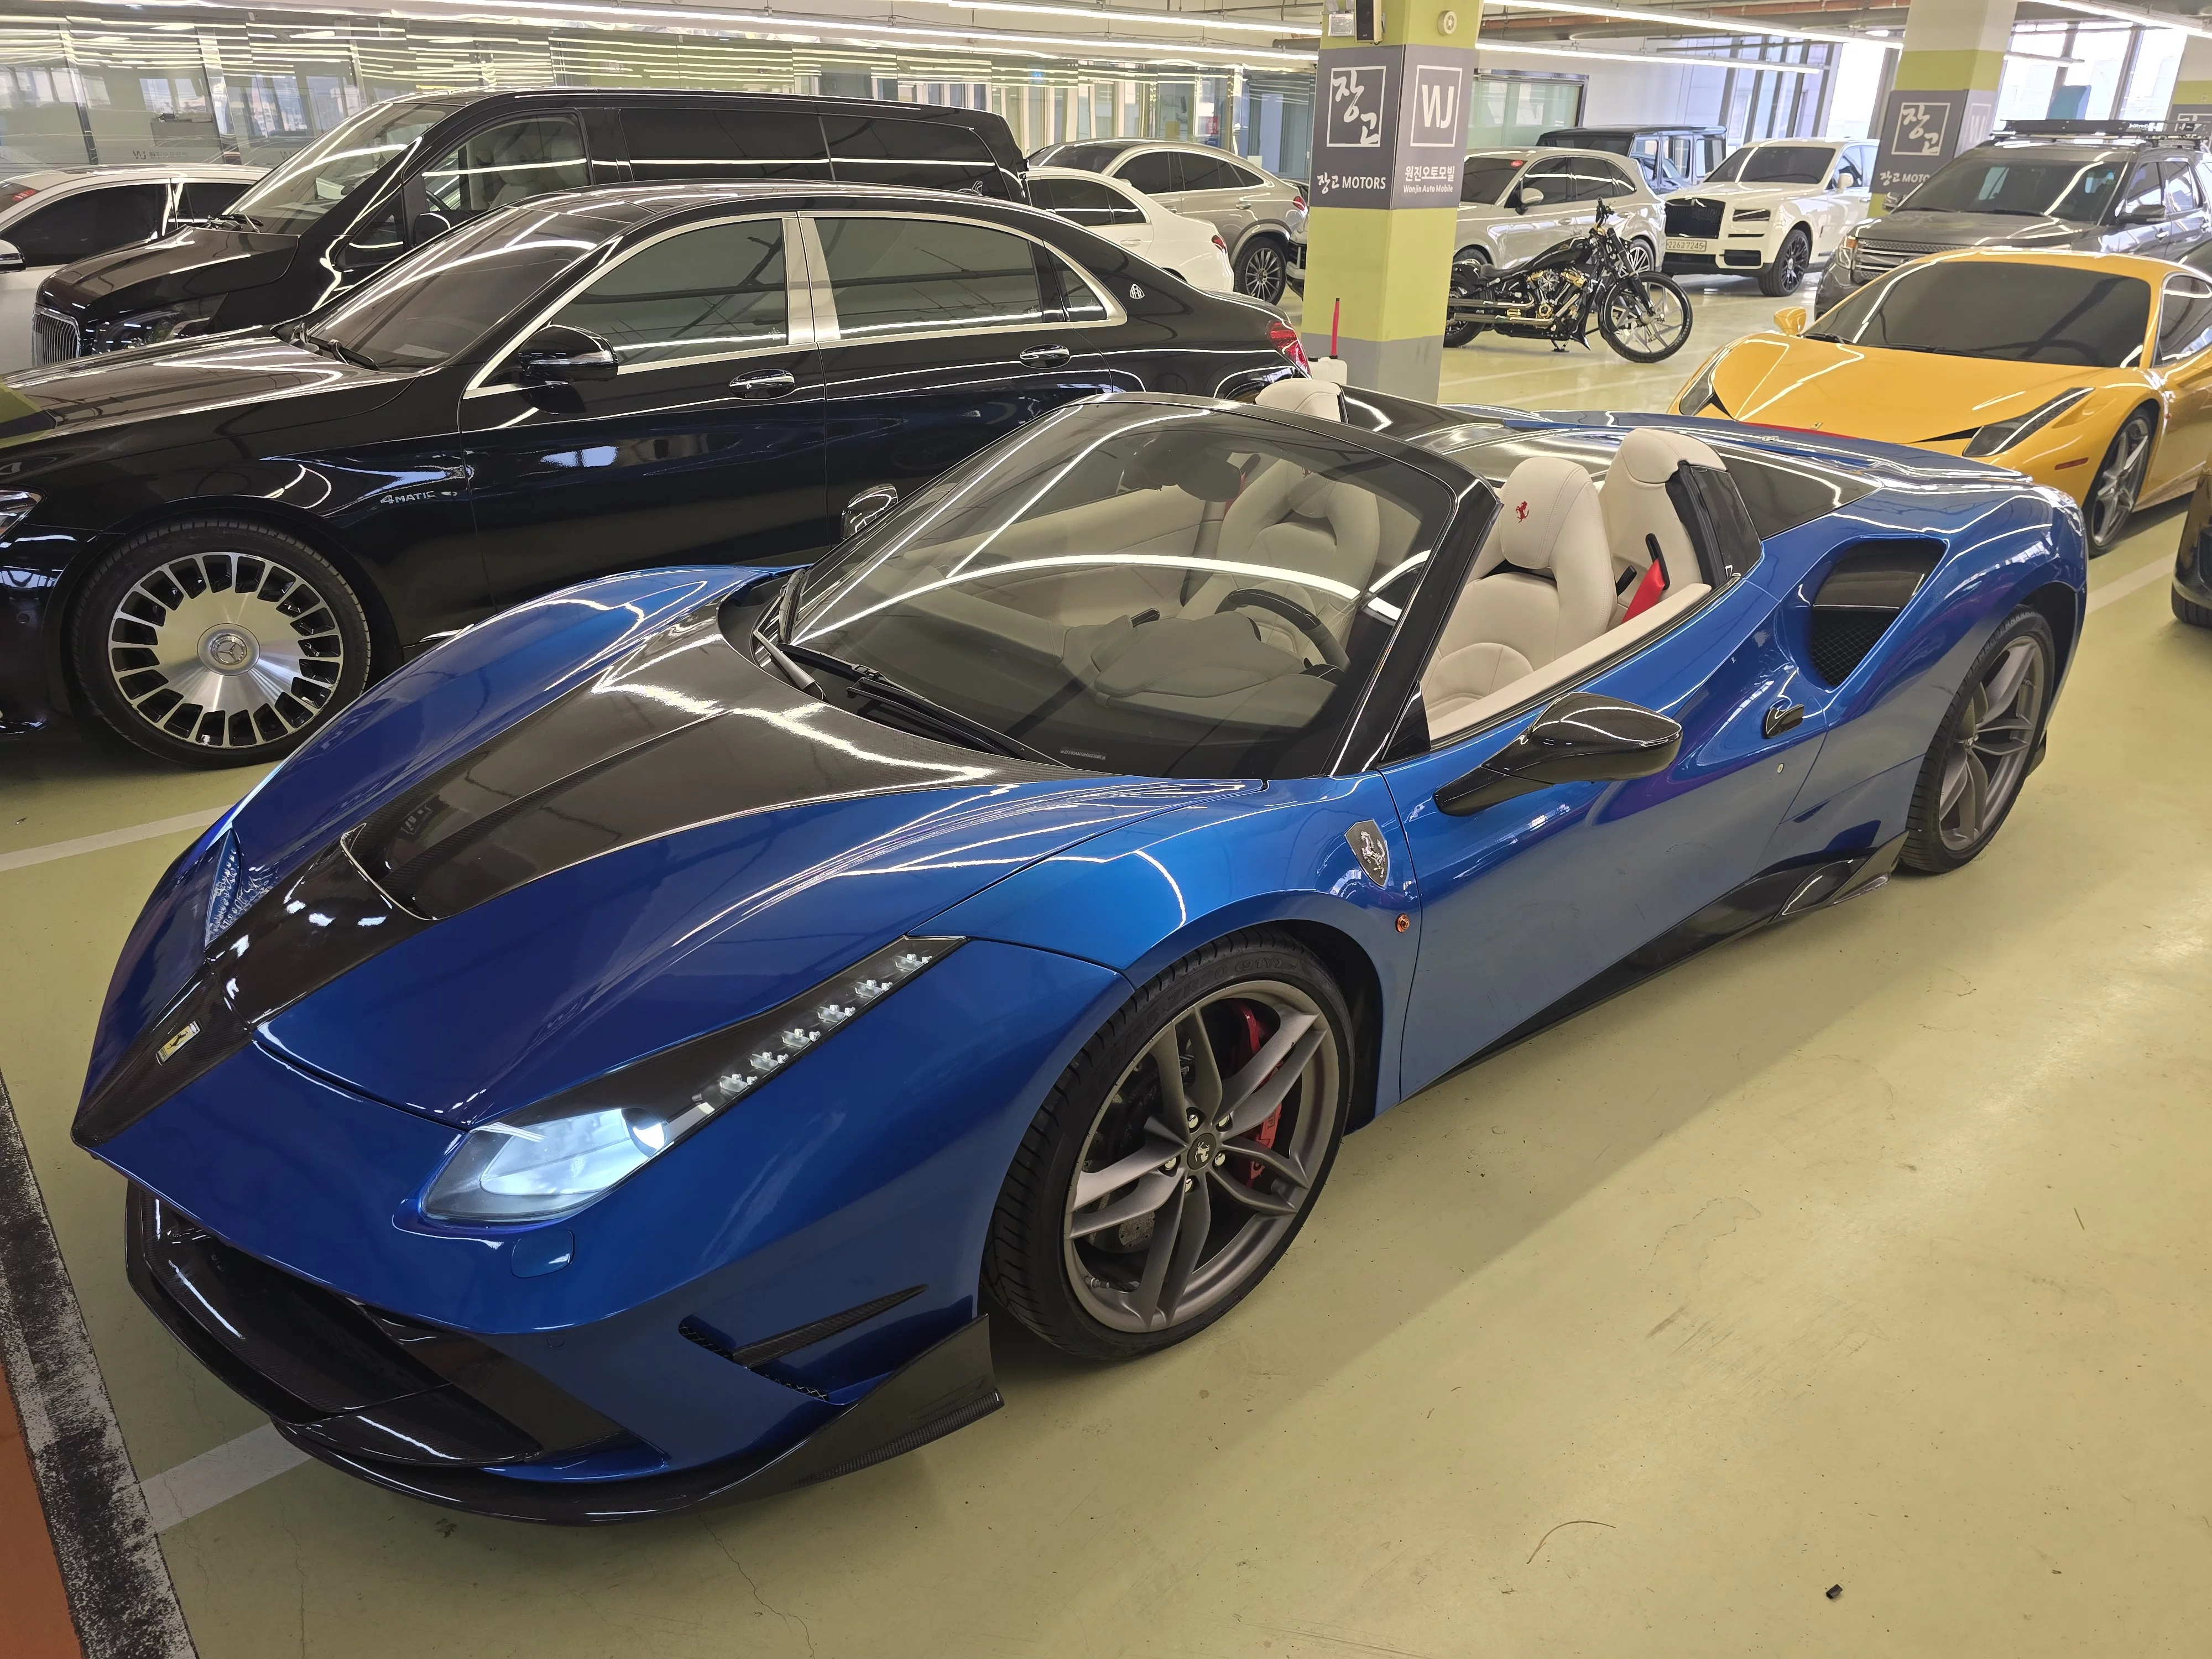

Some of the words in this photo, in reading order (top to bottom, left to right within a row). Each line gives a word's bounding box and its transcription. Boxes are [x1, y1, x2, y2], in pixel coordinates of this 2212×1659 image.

[1422, 85, 1454, 129] WJ
[1405, 165, 1455, 181] 원진오토모빌
[1317, 172, 1339, 194] 장고
[1342, 176, 1386, 190] MOTORS
[1403, 185, 1422, 194] Wonjin
[1422, 184, 1435, 192] Auto
[1436, 184, 1453, 193] Mobile
[1686, 242, 1704, 250] 7245
[380, 491, 435, 504] 4MATIC
